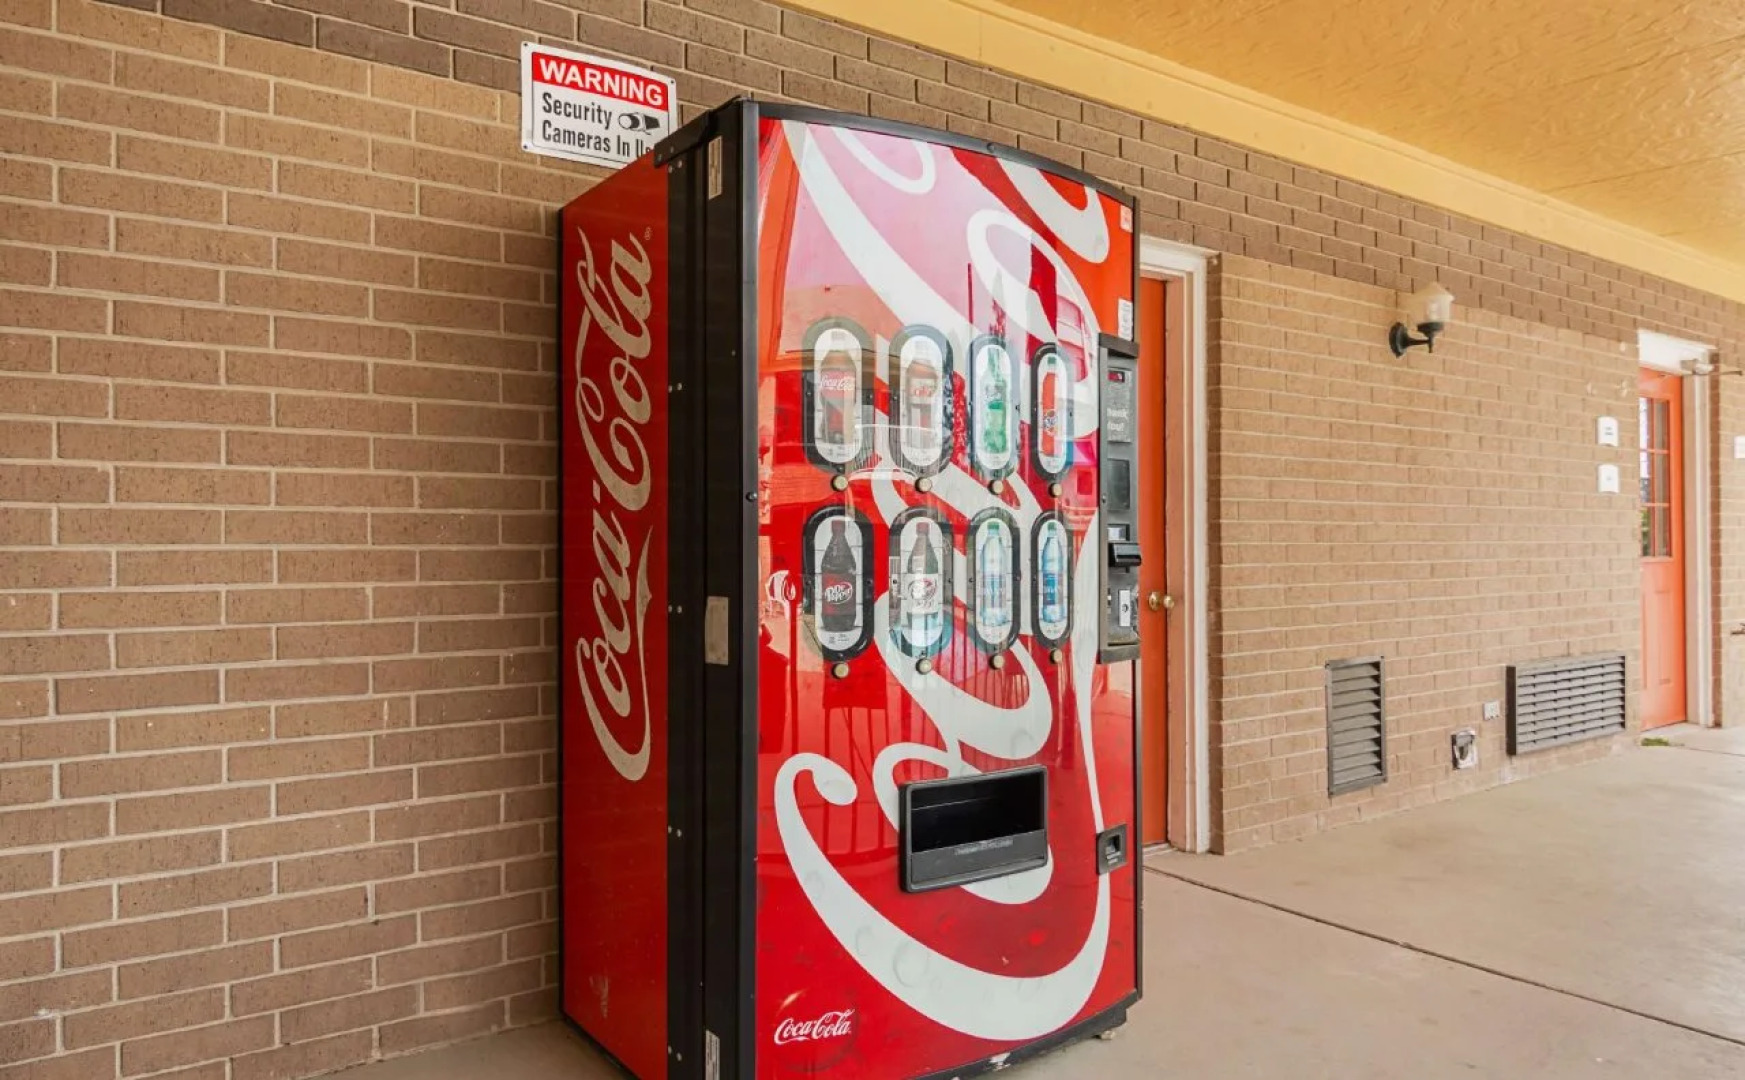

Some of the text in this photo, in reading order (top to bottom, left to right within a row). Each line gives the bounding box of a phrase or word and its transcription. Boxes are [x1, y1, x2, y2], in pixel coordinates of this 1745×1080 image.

[539, 58, 663, 106] WARNING
[542, 92, 612, 130] Security
[542, 120, 611, 153] Cameras
[617, 135, 630, 157] In
[576, 226, 653, 781] Coca-Cola
[773, 1009, 855, 1045] Coca-Cola
